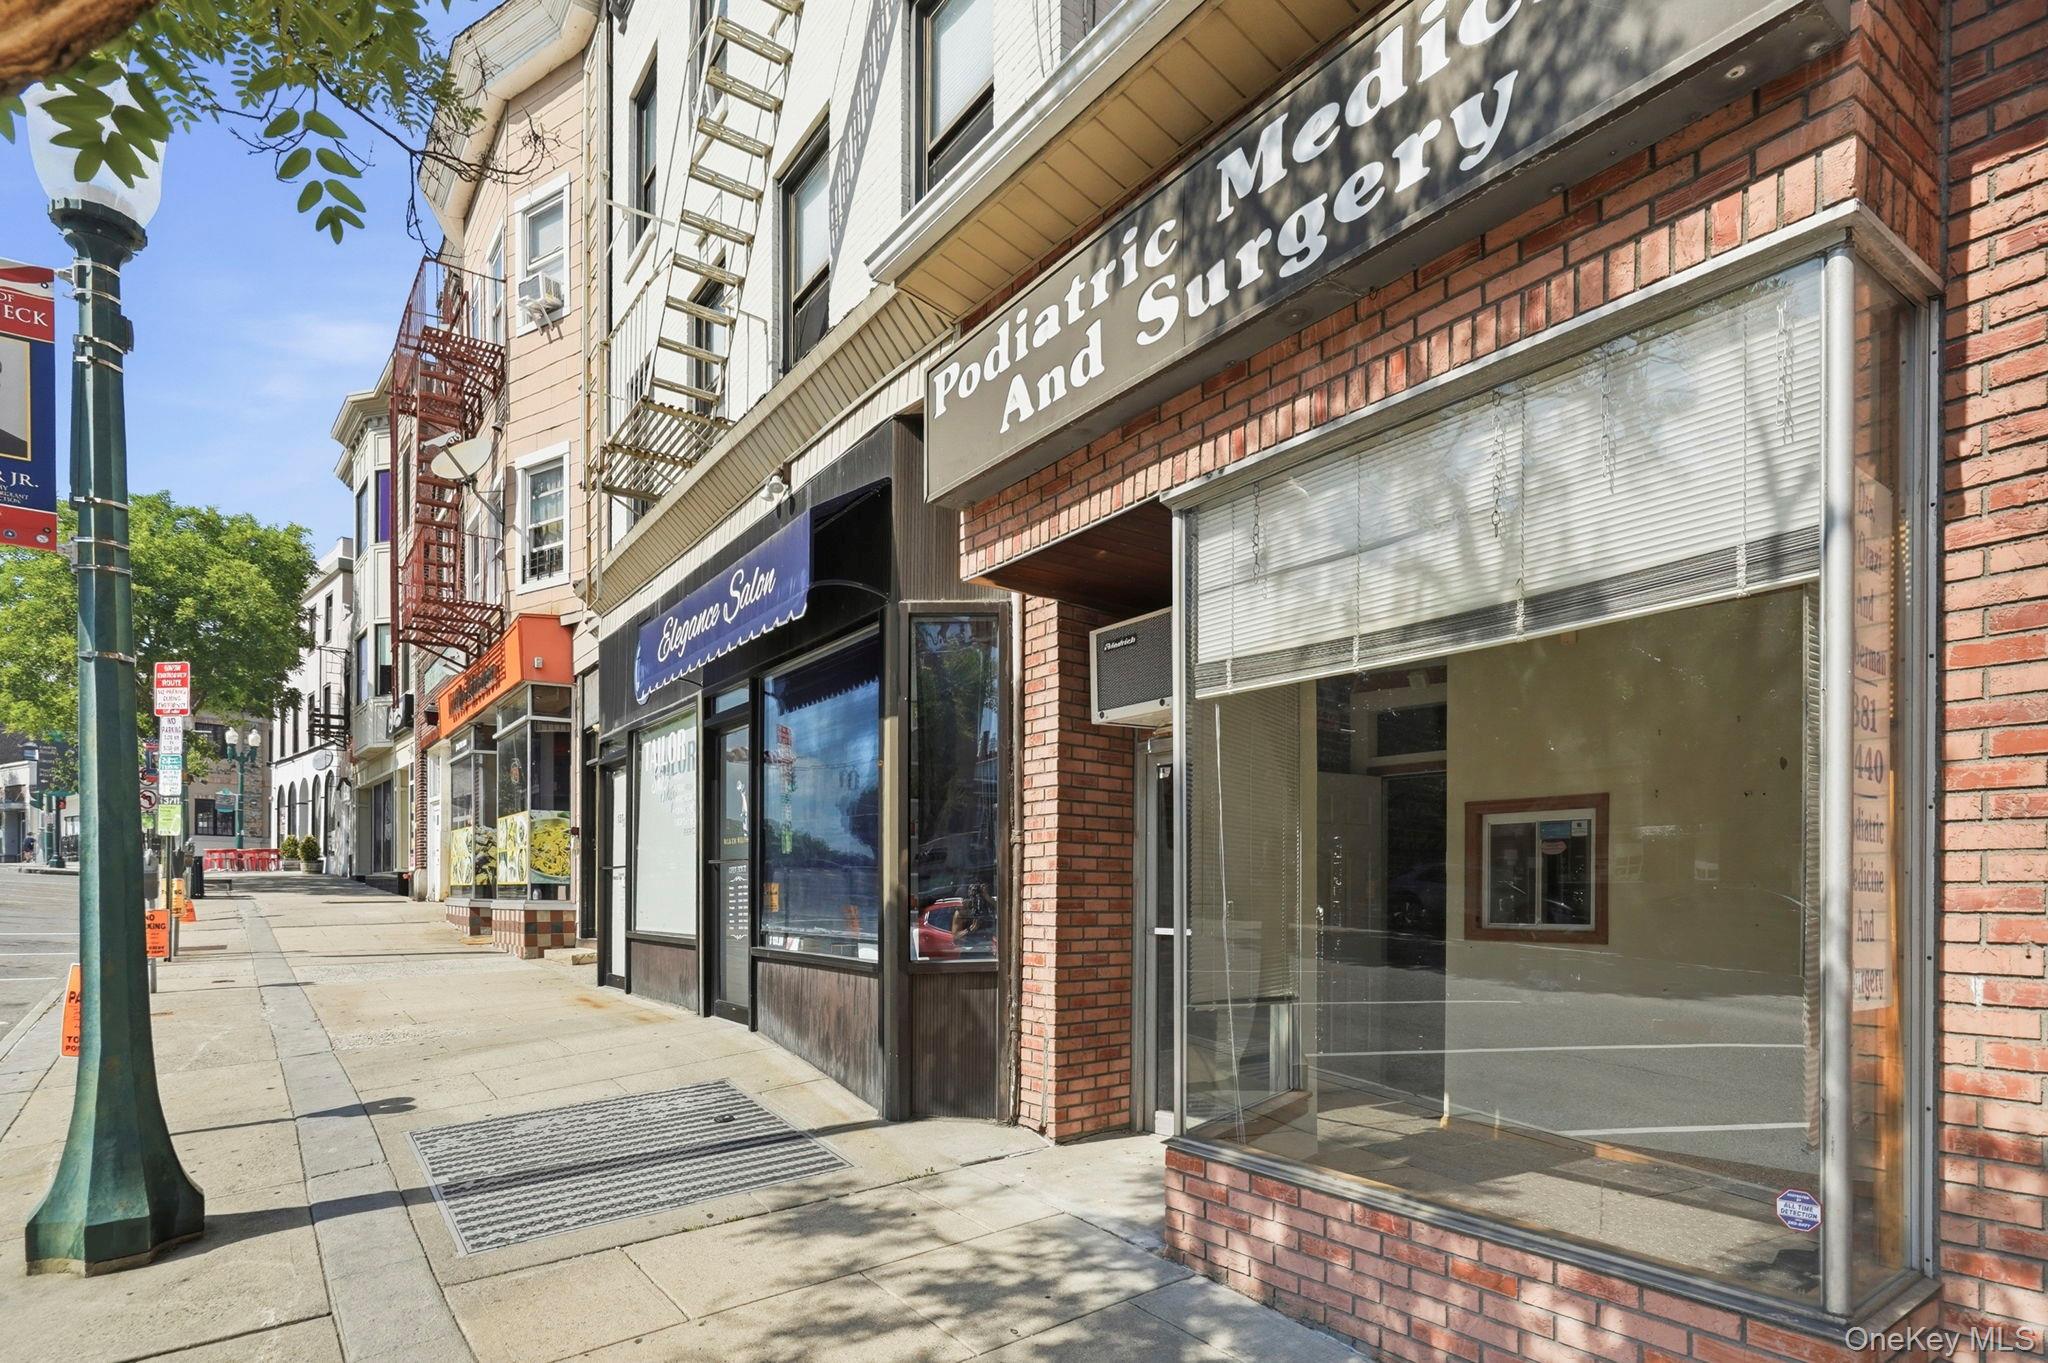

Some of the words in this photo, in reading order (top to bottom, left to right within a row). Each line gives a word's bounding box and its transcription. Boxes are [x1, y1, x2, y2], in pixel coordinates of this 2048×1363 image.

[934, 219, 1178, 419] Podiatric
[1216, 0, 1543, 222] Medic
[1000, 319, 1105, 434] And
[1136, 70, 1518, 346] Surgery
[10, 471, 39, 488] JR.
[657, 603, 720, 662] Elegance
[723, 566, 777, 624] Salon
[643, 728, 687, 772] TAILOR
[1855, 744, 1883, 784] 440
[1780, 1208, 1818, 1219] DETECTION
[1798, 1204, 1814, 1213] TIME
